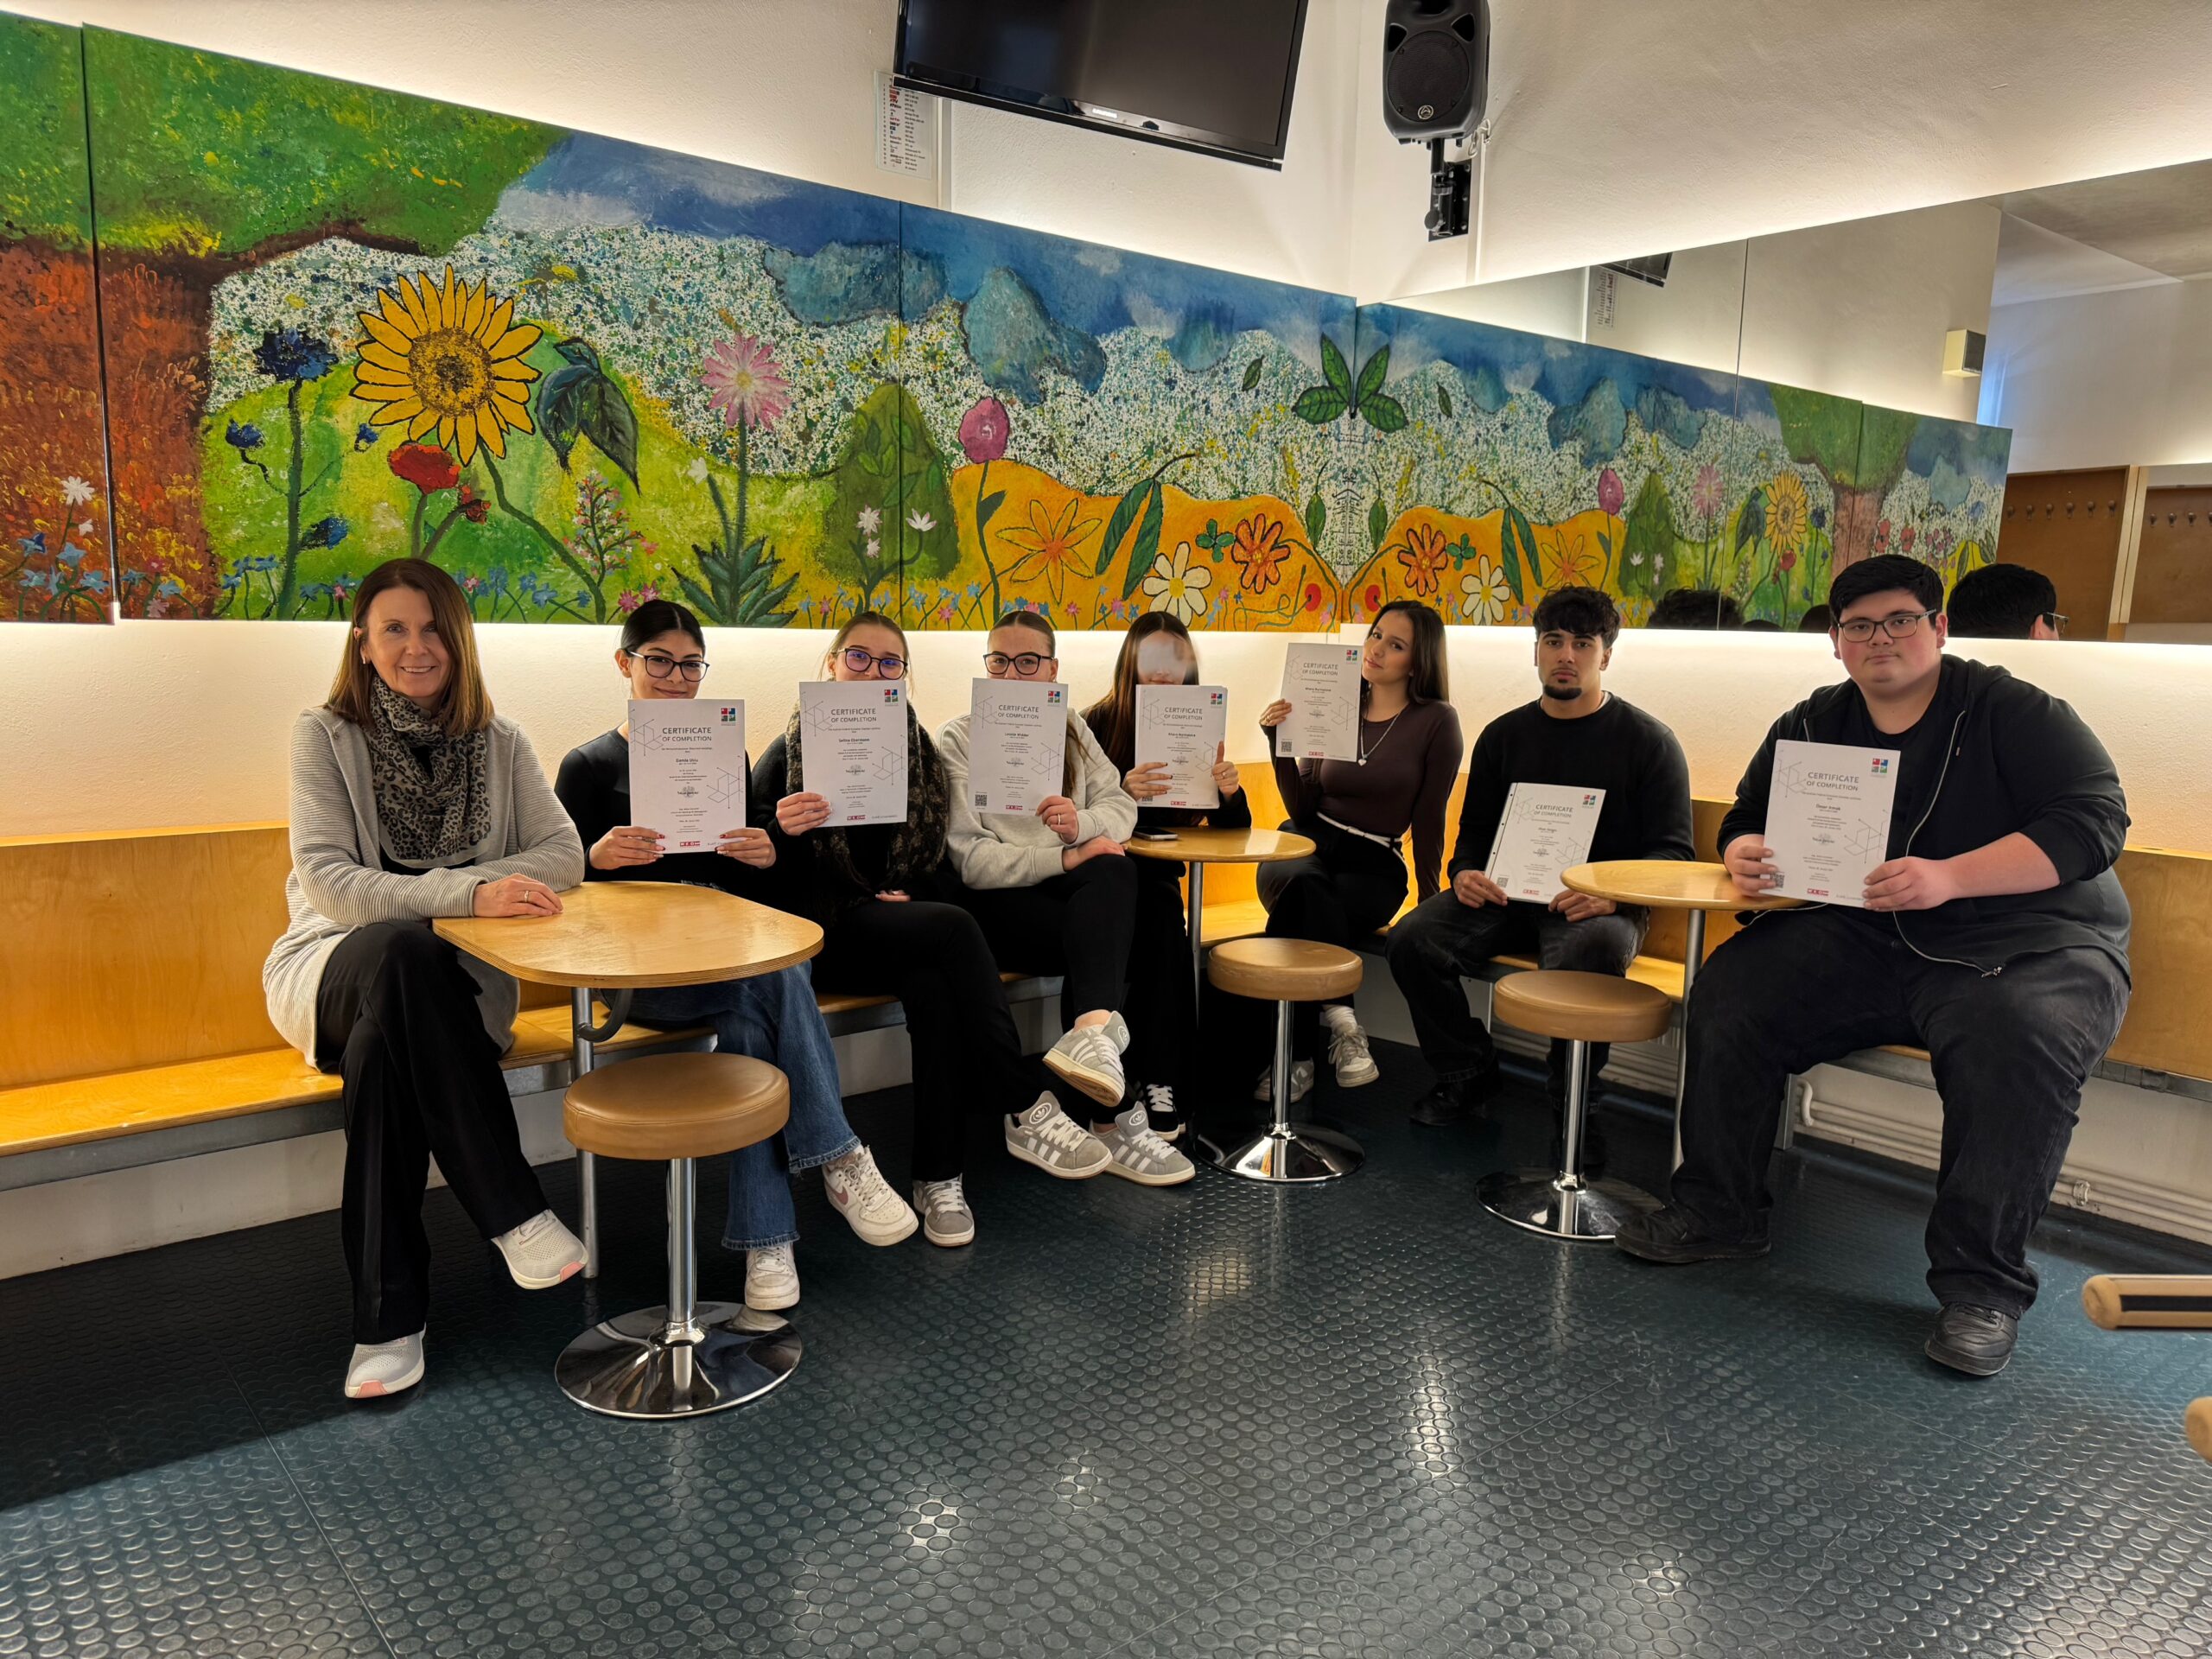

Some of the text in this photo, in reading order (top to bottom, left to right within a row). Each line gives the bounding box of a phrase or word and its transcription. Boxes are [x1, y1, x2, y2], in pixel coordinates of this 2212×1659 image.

[998, 704, 1039, 713] CERTIFICATE
[1808, 772, 1859, 784] CERTIFICATE
[1816, 781, 1859, 791] COMPLETION
[1535, 804, 1573, 813] CERTIFICATE
